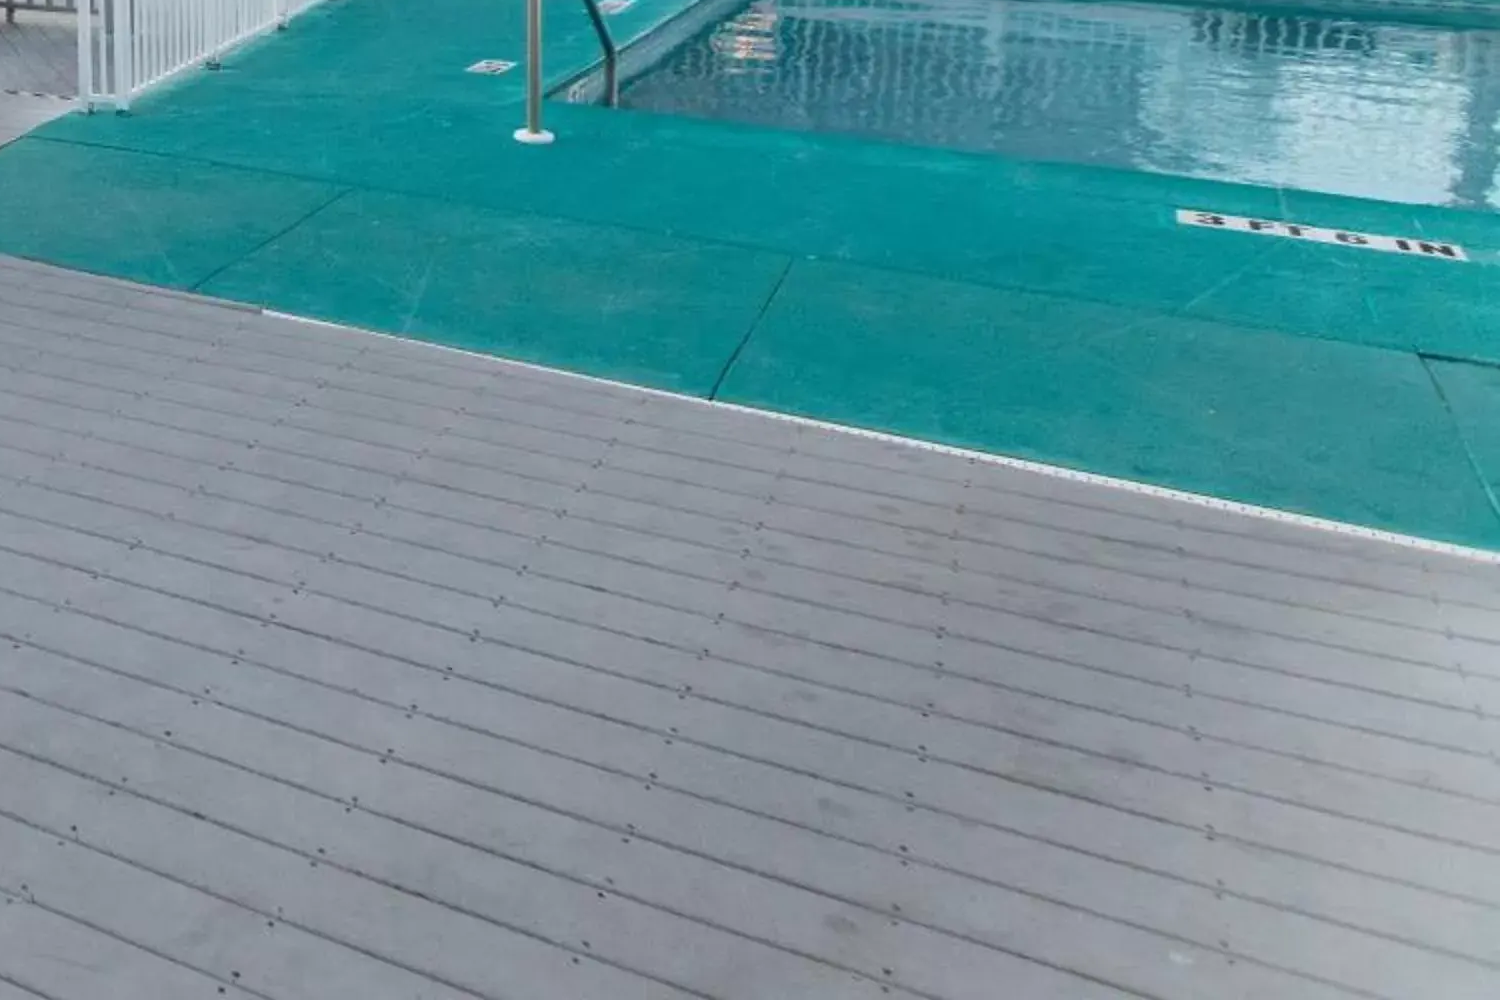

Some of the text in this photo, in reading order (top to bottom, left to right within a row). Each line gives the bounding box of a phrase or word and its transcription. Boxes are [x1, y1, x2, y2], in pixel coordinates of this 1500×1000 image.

[1194, 212, 1225, 226] 3
[1247, 219, 1309, 237] FT
[1395, 239, 1457, 257] IN
